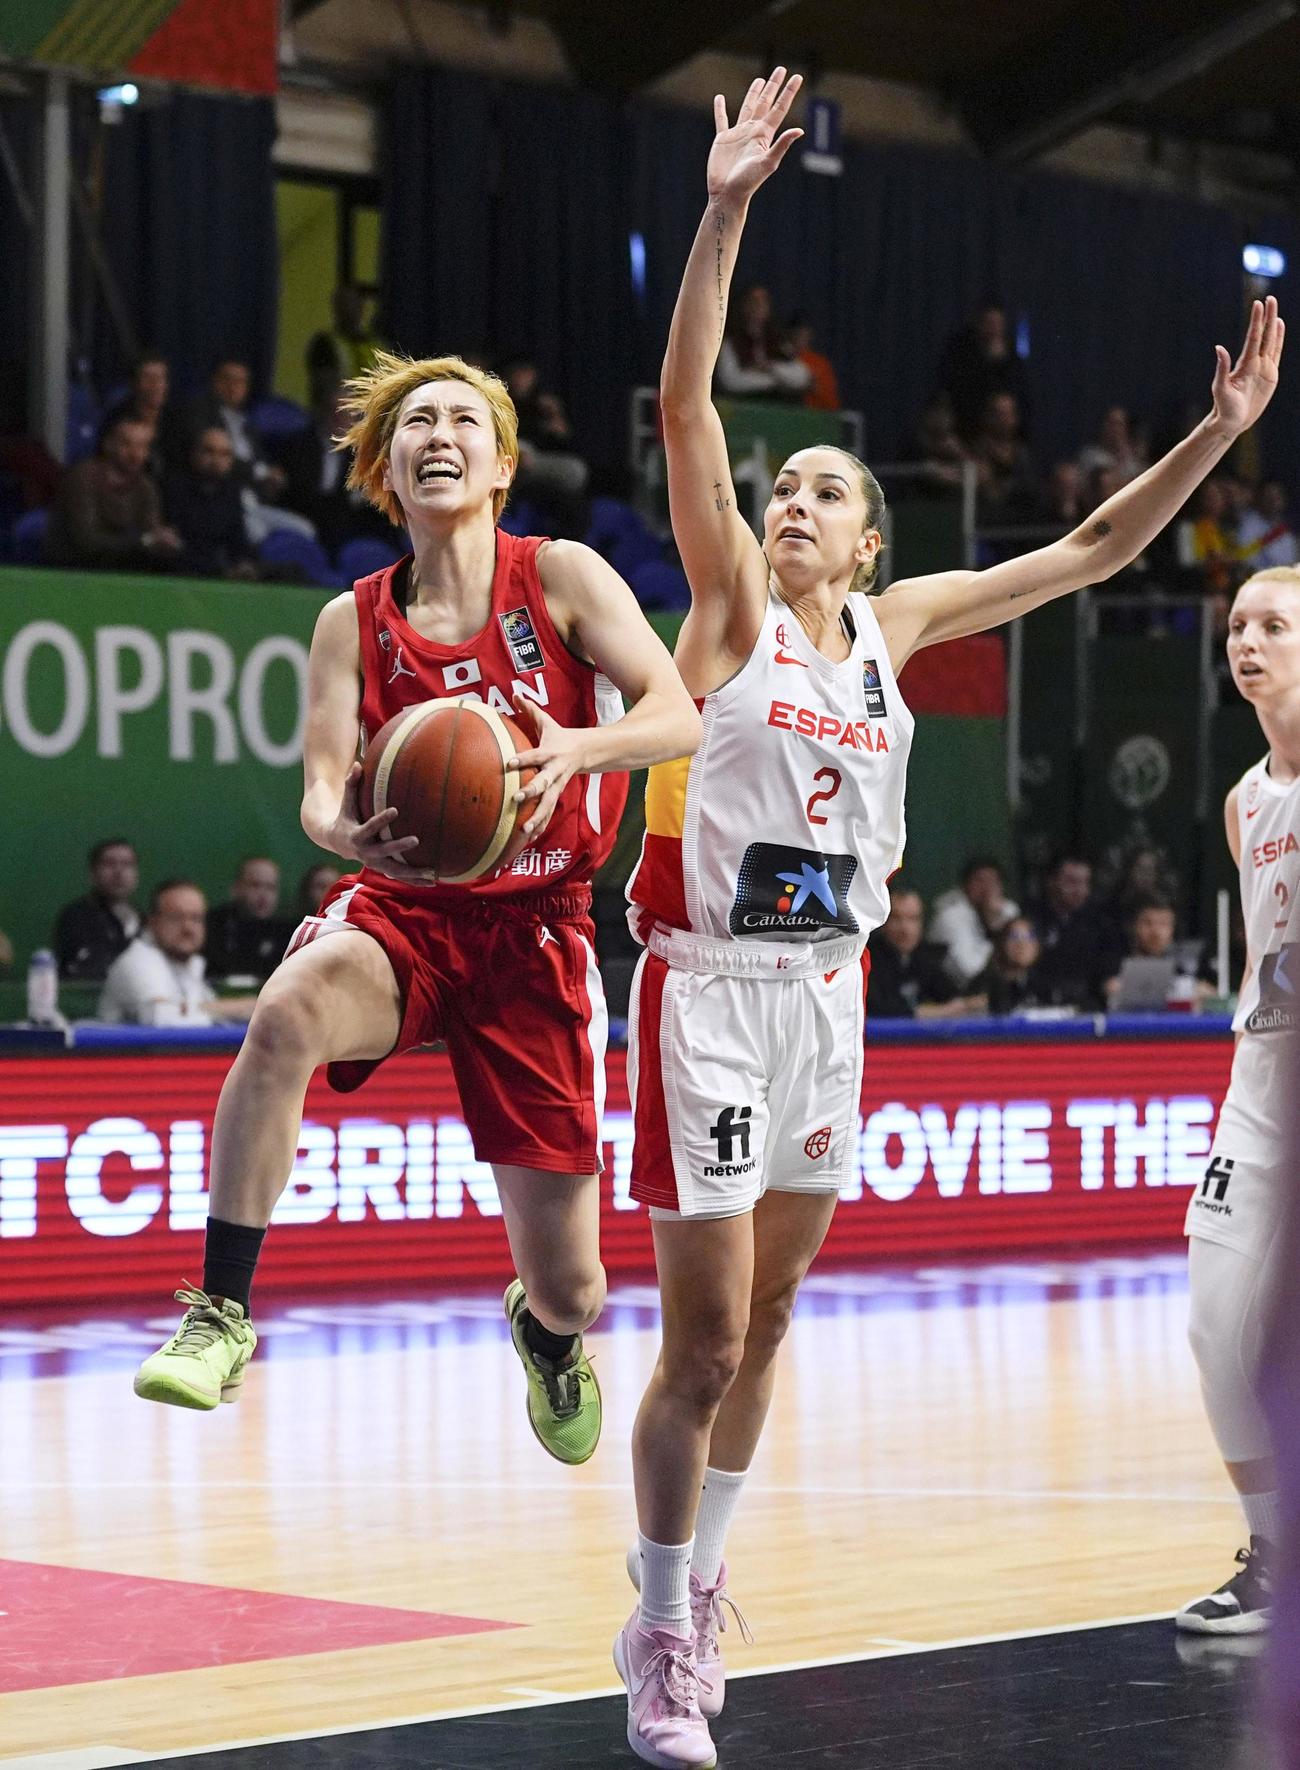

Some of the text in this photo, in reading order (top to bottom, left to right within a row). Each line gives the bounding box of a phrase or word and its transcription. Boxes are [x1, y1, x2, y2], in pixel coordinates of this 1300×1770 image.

[513, 643, 536, 657] FIBA
[0, 619, 310, 767] OPRO
[767, 700, 889, 753] ESPAÑA
[807, 767, 842, 825] 2
[495, 848, 572, 878] 動産
[709, 1106, 753, 1163] fi
[269, 1119, 503, 1225] BRIN
[703, 1157, 757, 1177] network
[1201, 1156, 1235, 1202] fi
